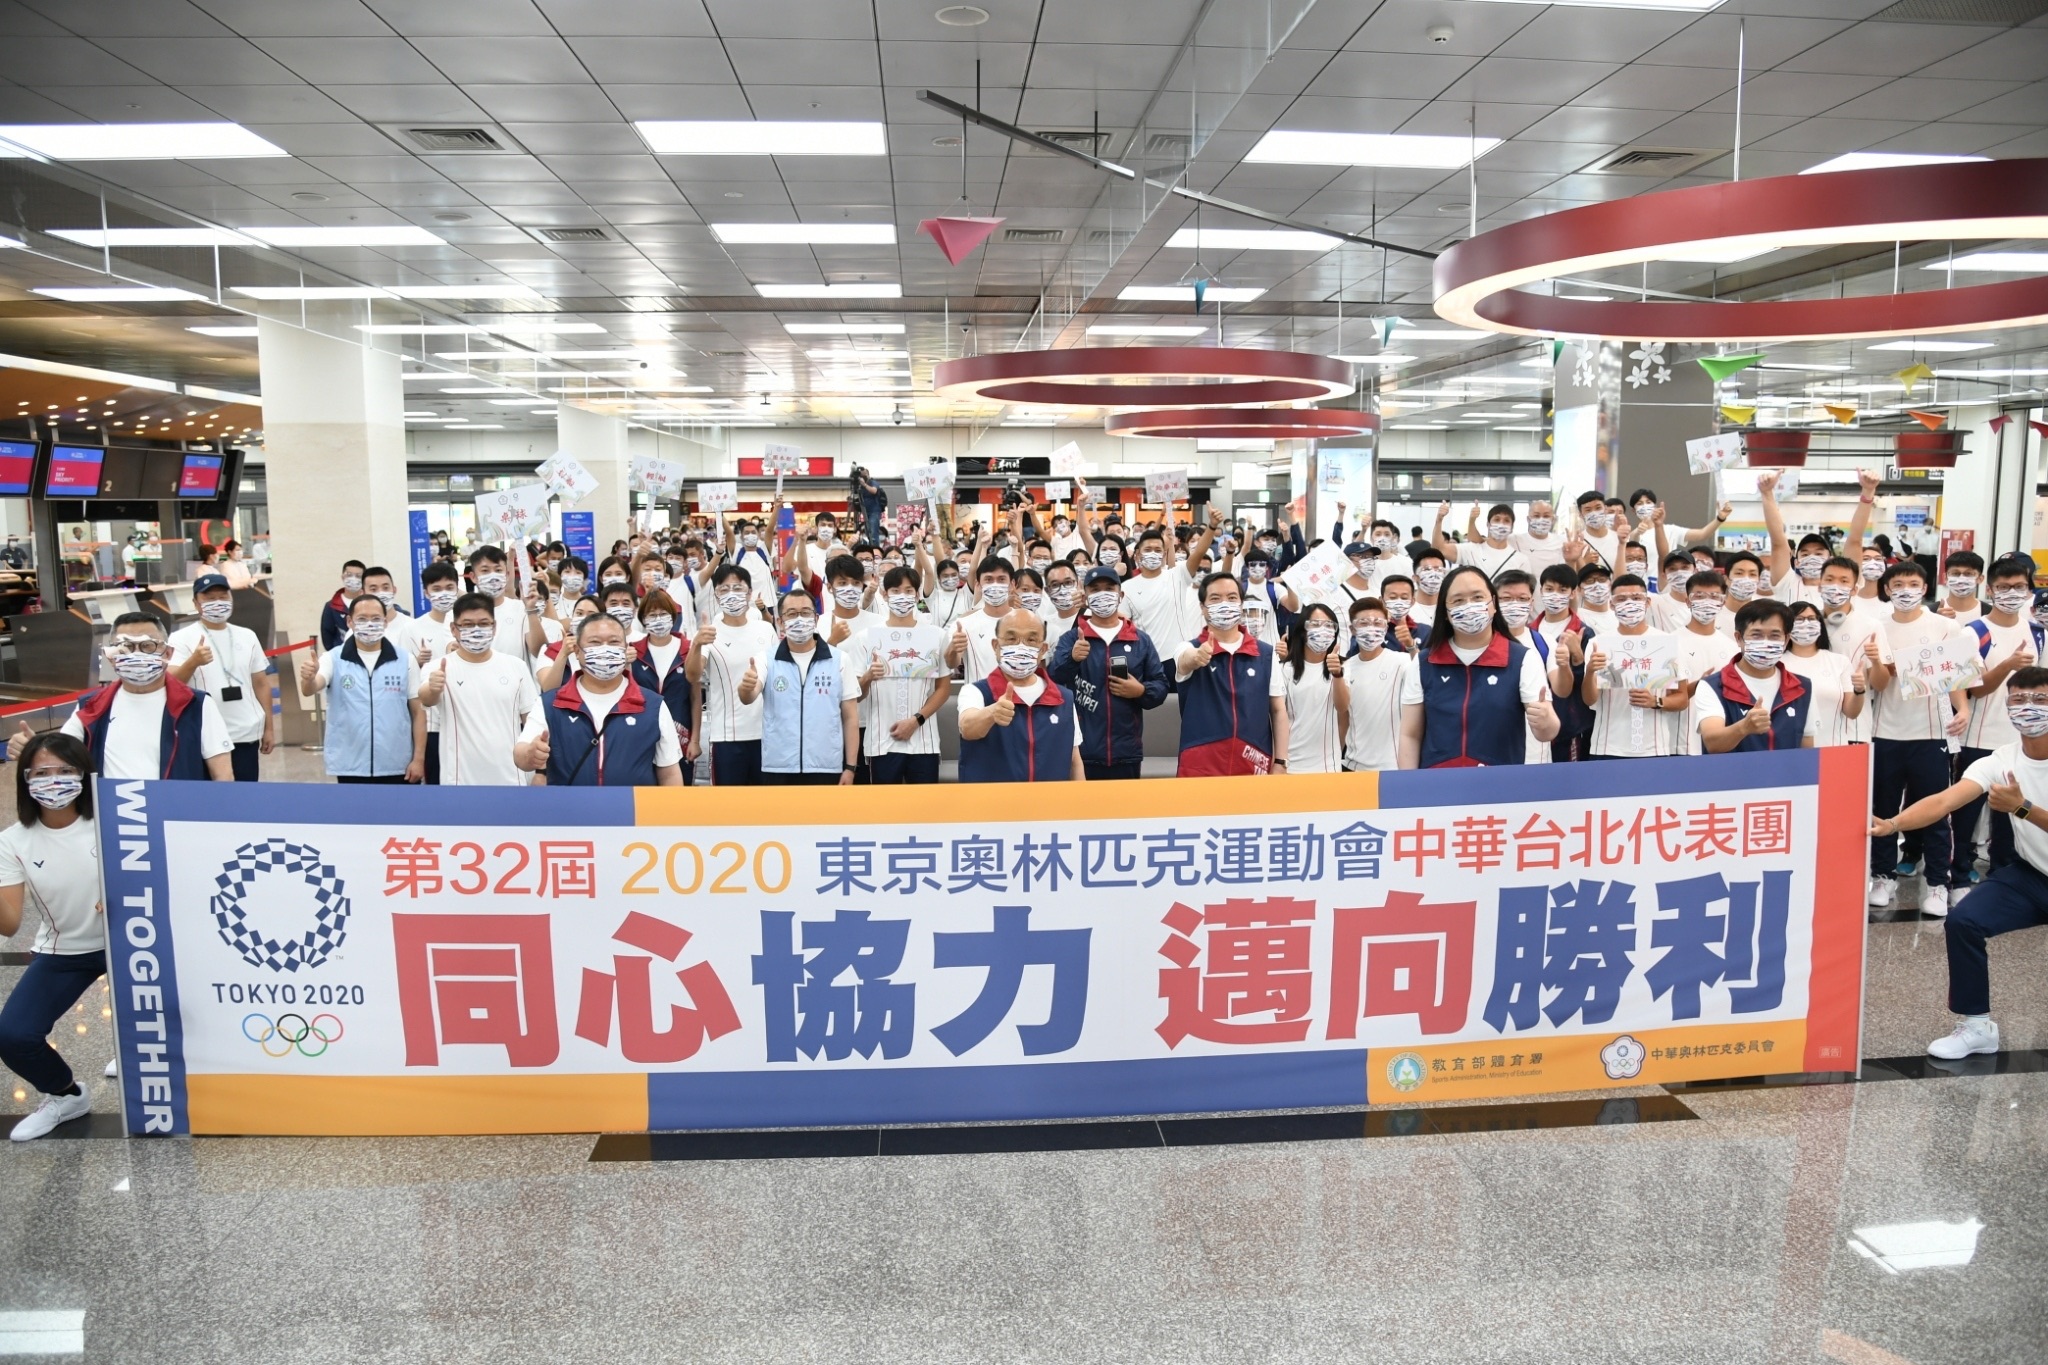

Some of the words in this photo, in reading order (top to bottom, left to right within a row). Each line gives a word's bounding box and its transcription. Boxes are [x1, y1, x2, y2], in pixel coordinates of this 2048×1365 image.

[104, 480, 112, 492] 2
[171, 481, 177, 492] 1
[500, 508, 529, 523] 桌球
[1309, 565, 1331, 584] 體操
[1621, 658, 1652, 670] 射箭
[1923, 661, 1954, 675] 羽球
[1074, 690, 1099, 713] TAIPEI
[1242, 745, 1270, 771] CHINESE
[115, 780, 151, 871] WIN
[381, 837, 597, 898] 第32屆
[620, 840, 792, 895] 2020
[391, 906, 1093, 1067] 同心協力
[1154, 869, 1794, 1051] 邁向勝利
[212, 982, 297, 1005] TOKYO
[304, 983, 365, 1005] 2020
[122, 887, 174, 1134] TOGETHER
[1651, 1039, 1775, 1060] 中華奧林匹克委員會
[1820, 1047, 1840, 1058] 廣告
[1432, 1053, 1543, 1072] 教育部體育署
[1489, 1071, 1509, 1079] Ministry
[1516, 1069, 1543, 1077] Education
